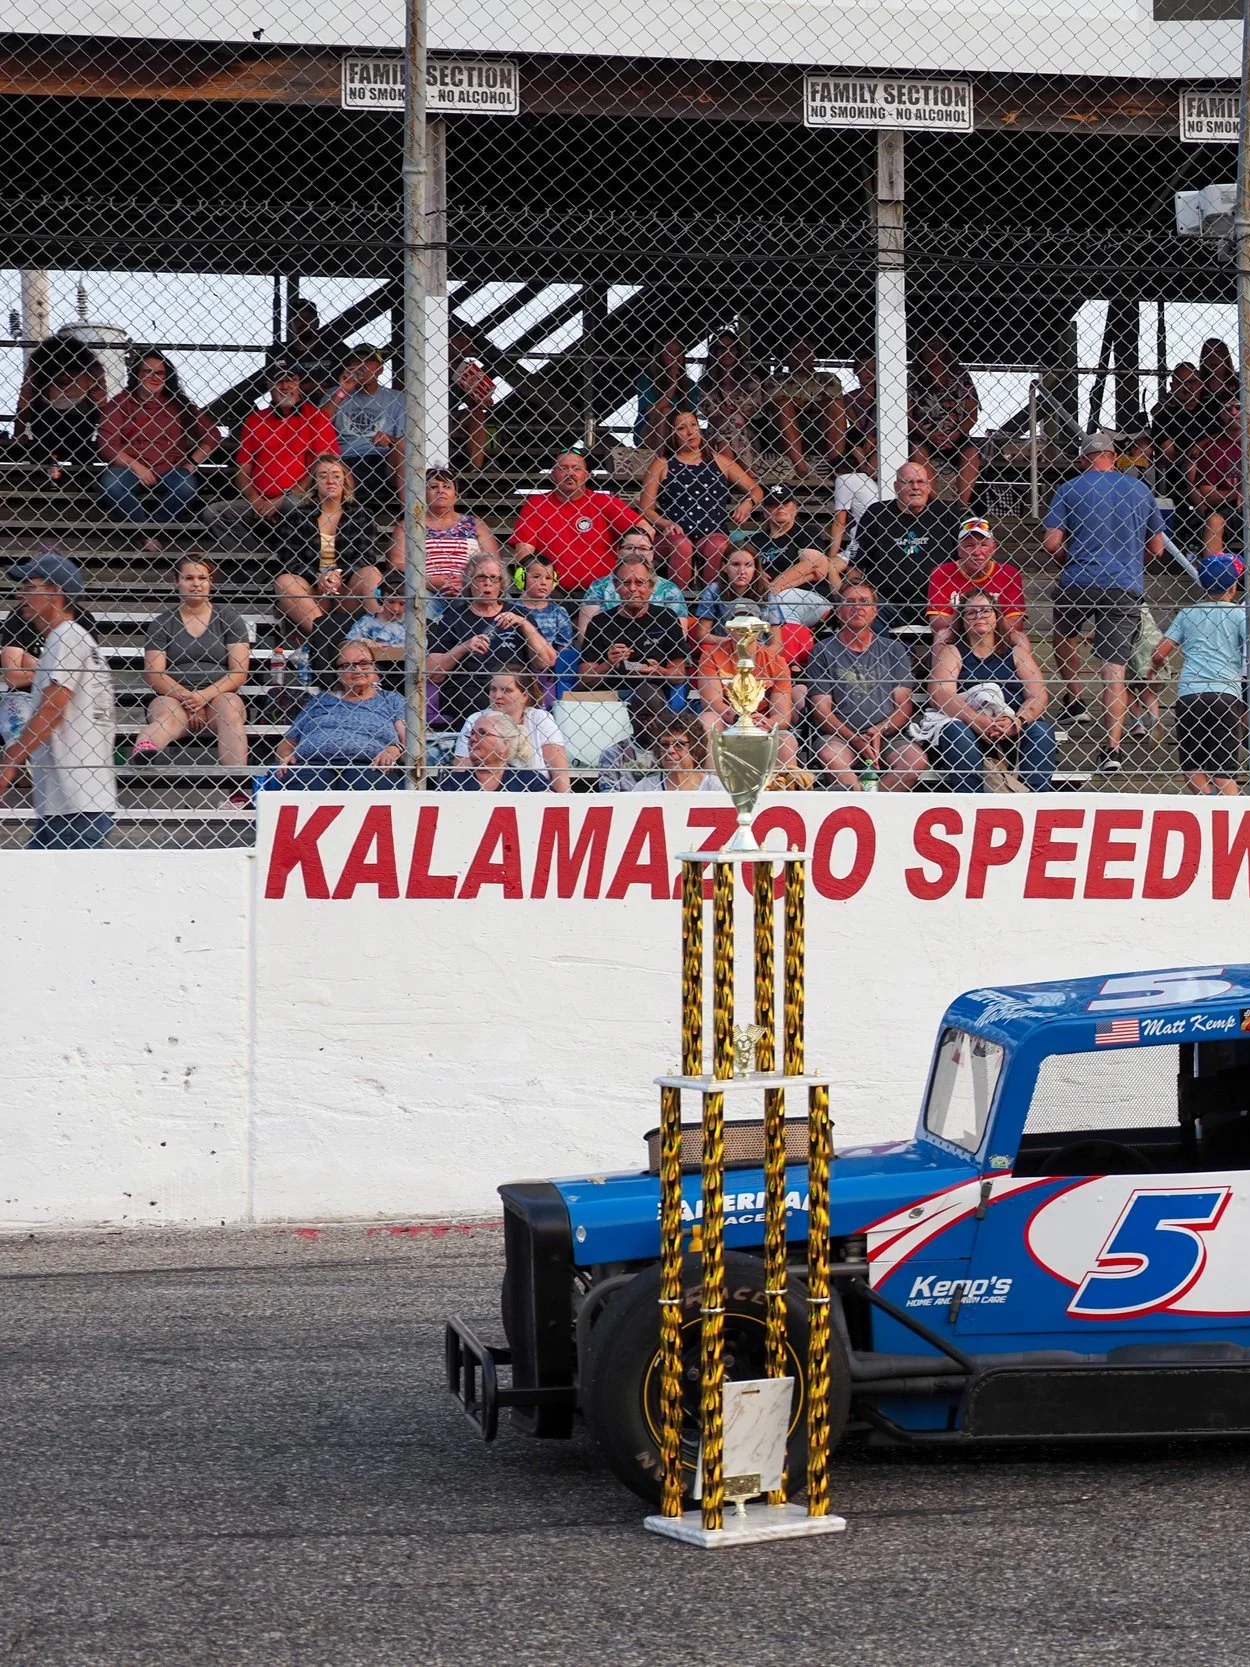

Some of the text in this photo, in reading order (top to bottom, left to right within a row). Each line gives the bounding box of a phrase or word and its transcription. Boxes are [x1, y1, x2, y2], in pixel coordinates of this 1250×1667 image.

[349, 63, 512, 89] FAMI SECTION
[350, 87, 366, 100] NO
[369, 87, 427, 101] SMOK
[439, 90, 454, 103] NO
[458, 90, 512, 104] ALCOHOL
[810, 82, 966, 107] FAMILY SECTION
[811, 106, 827, 118] NO
[830, 106, 886, 119] SMOKING
[896, 108, 912, 120] NO
[915, 108, 967, 122] ALCOHOL
[1187, 98, 1246, 118] FAMI
[1187, 120, 1203, 133] NO
[264, 805, 876, 901] KALAMAZOO
[1141, 1019, 1186, 1036] Matt
[1189, 1015, 1236, 1032] Kemp
[1066, 1185, 1233, 1322] 5
[909, 1275, 1013, 1298] Kemp's
[906, 1298, 933, 1307] HOME
[958, 1296, 981, 1304] AWN
[981, 1295, 1007, 1304] CARE
